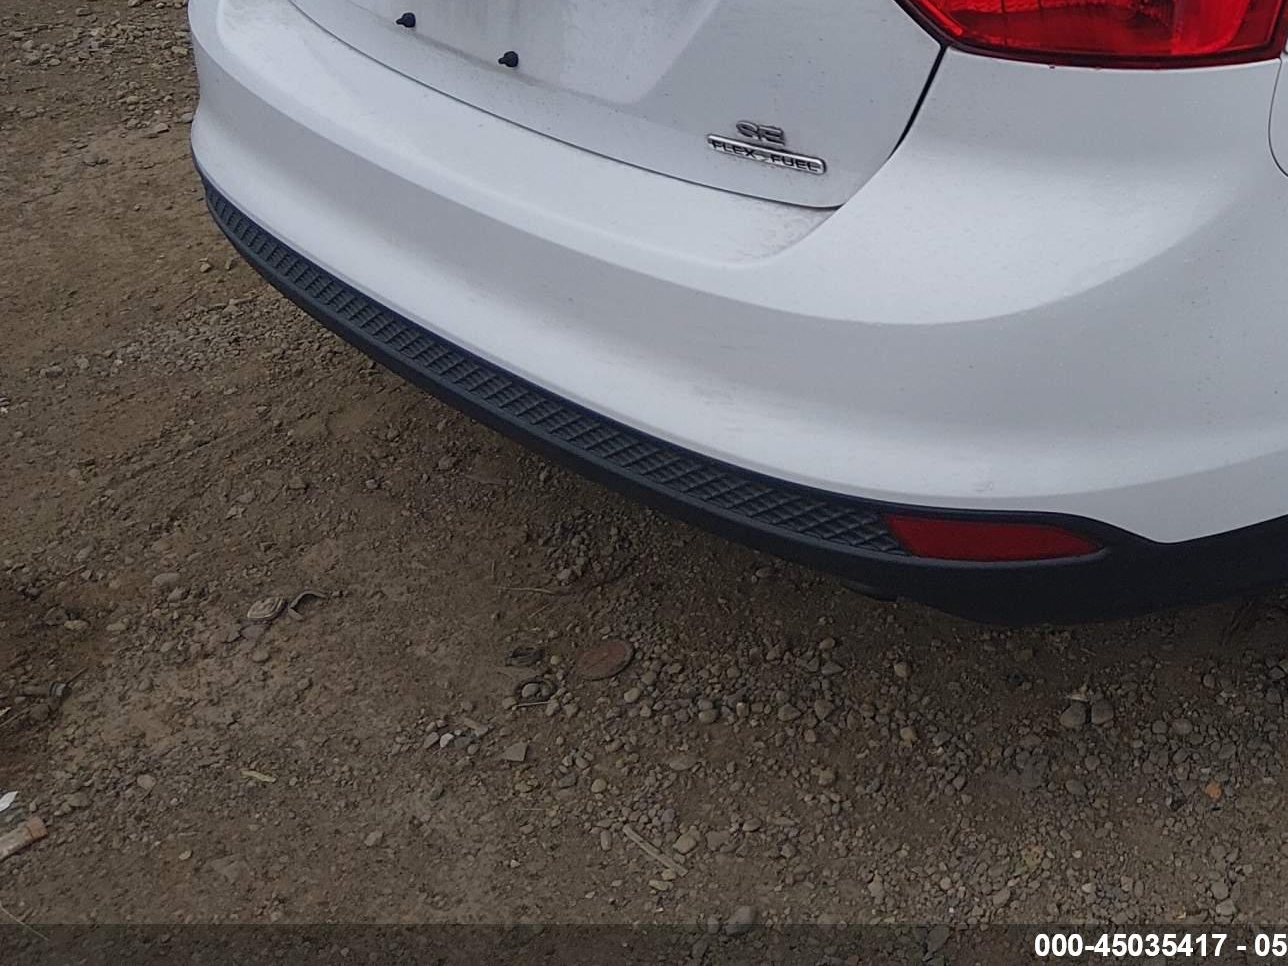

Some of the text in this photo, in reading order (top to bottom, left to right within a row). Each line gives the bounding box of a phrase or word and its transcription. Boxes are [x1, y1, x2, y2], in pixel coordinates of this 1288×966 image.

[736, 120, 786, 146] SE
[710, 138, 819, 173] FLEX FUEL
